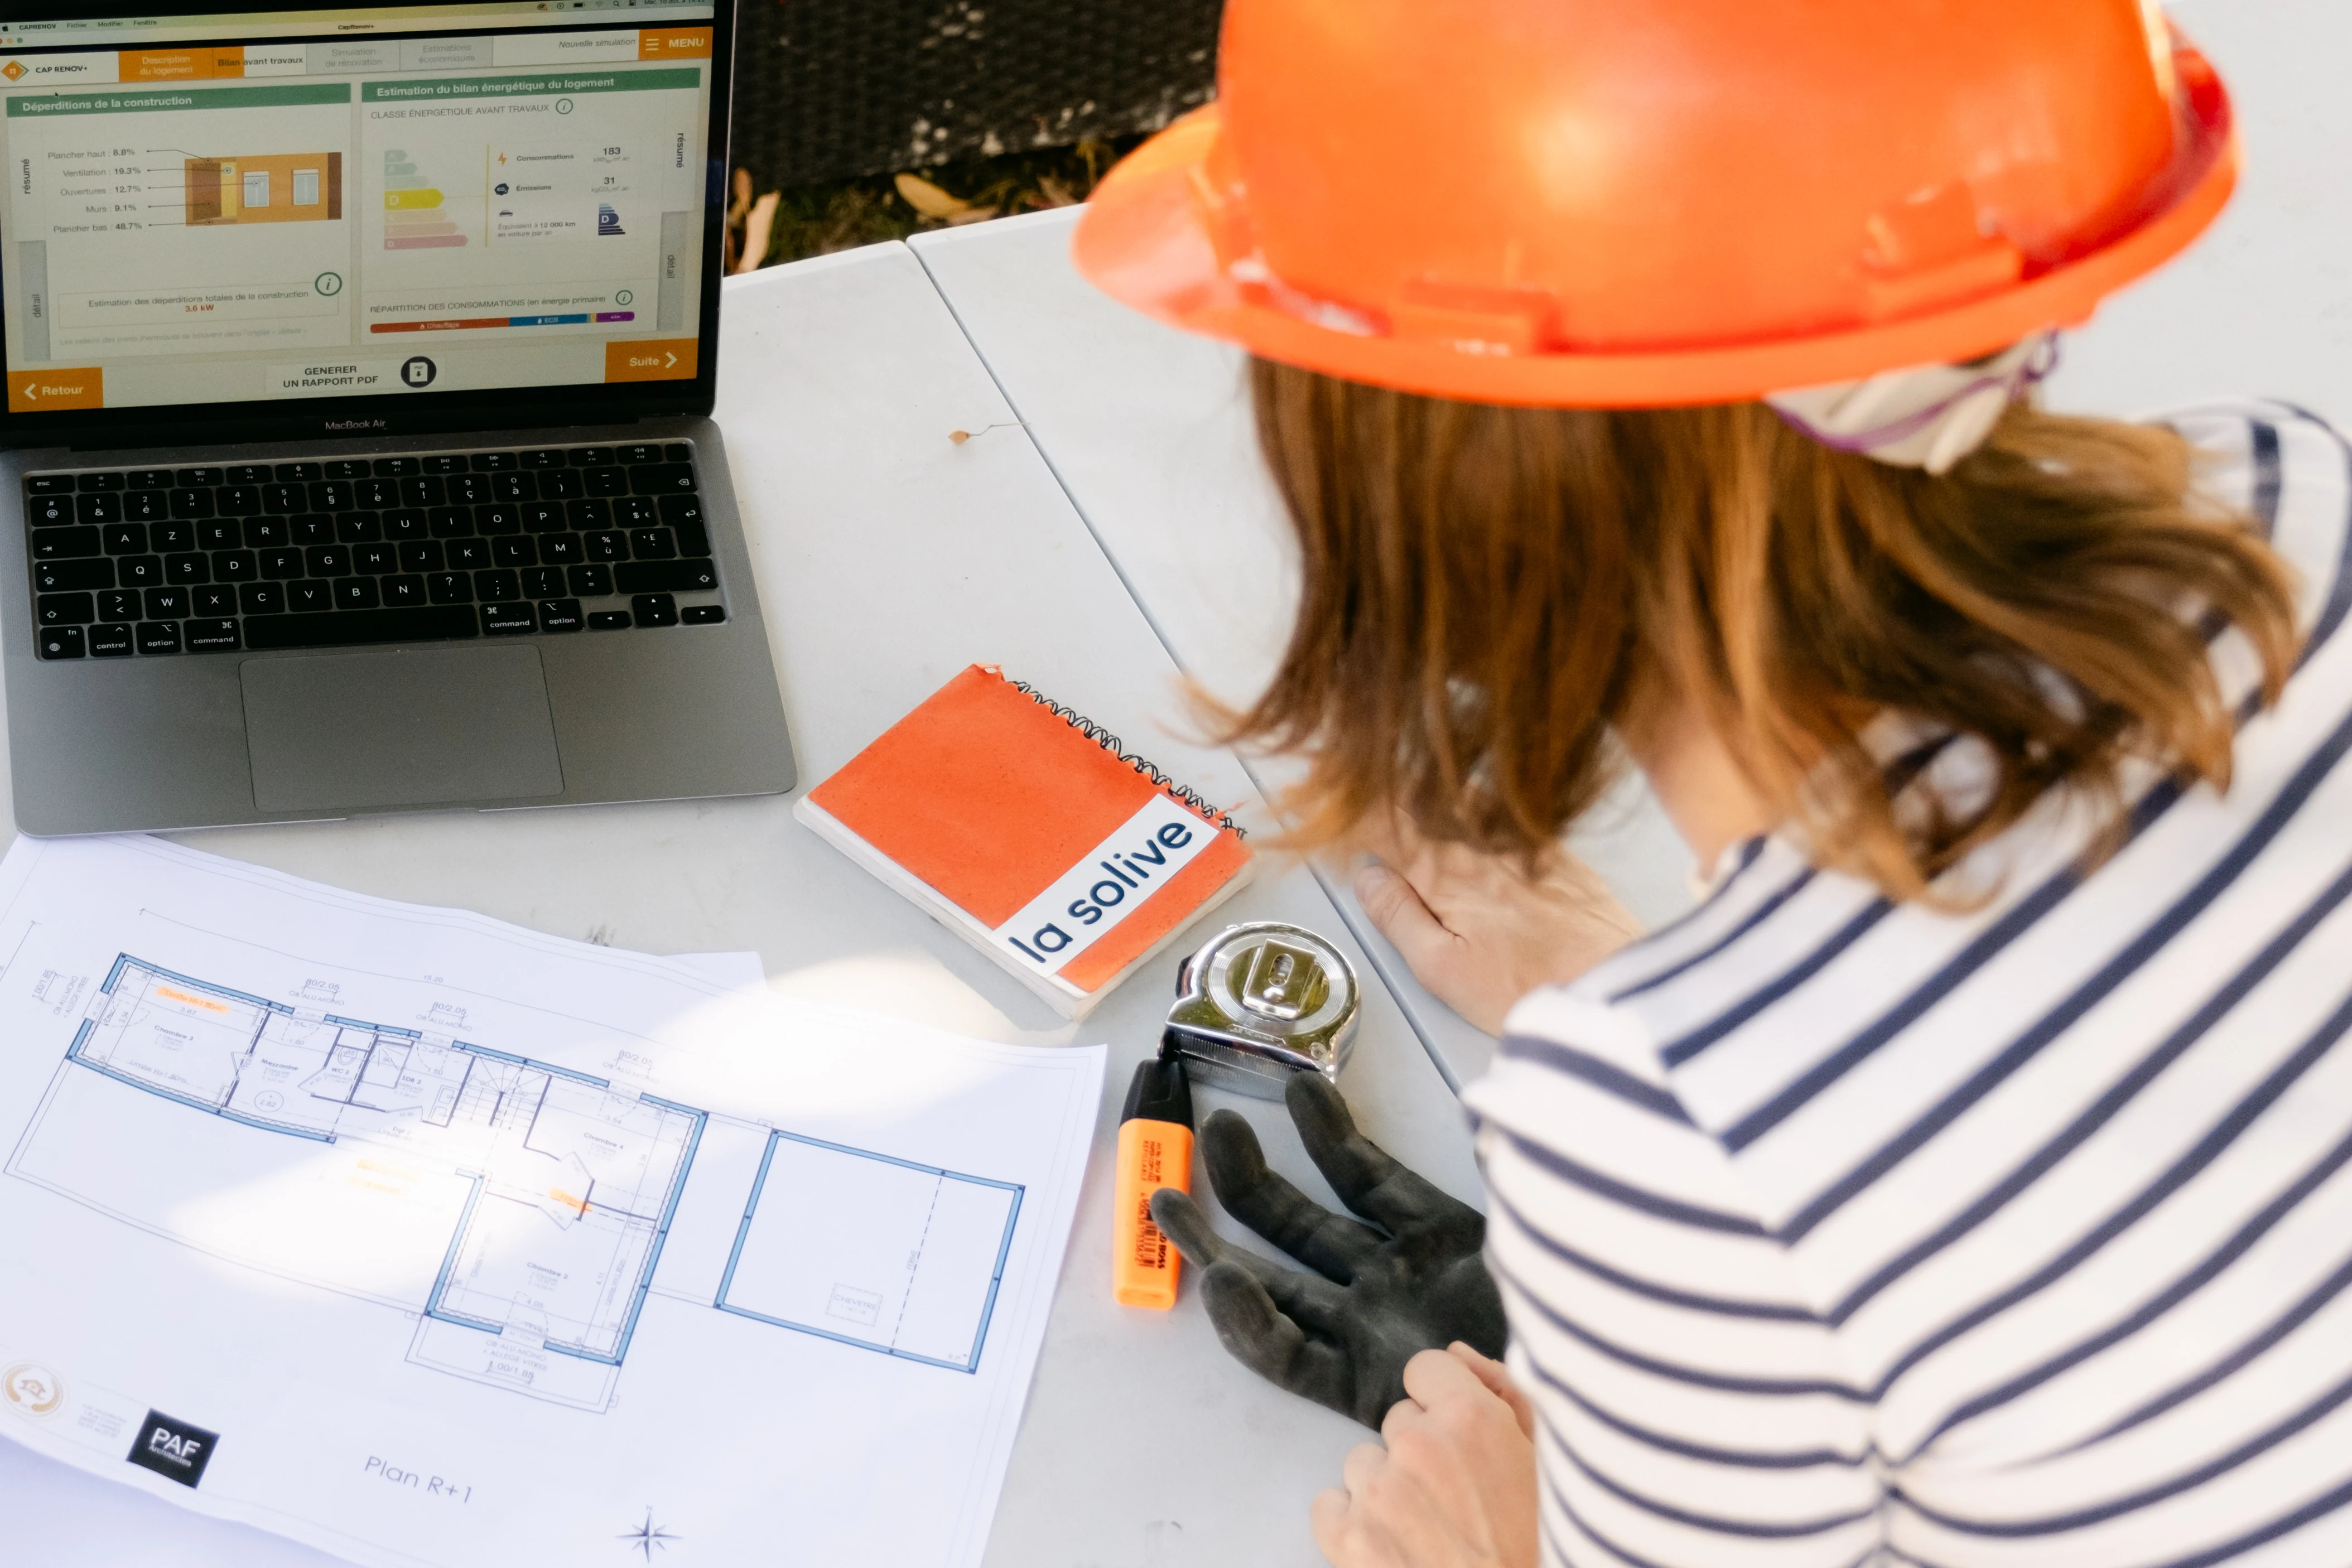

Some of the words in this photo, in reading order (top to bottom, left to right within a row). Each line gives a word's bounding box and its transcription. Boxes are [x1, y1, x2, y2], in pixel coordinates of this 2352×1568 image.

[558, 40, 593, 49] Nouvelle
[595, 38, 635, 47] simulation
[669, 38, 704, 47] MENU
[331, 48, 376, 57] Simulation
[423, 45, 471, 53] Estimations
[142, 56, 190, 65] Description
[338, 59, 383, 67] rénovation
[418, 55, 475, 64] économiques
[153, 66, 193, 76] logement
[377, 86, 433, 97] Estimation
[436, 85, 450, 94] du
[453, 84, 478, 93] bilan
[481, 81, 545, 94] énergétique
[548, 80, 561, 89] du
[564, 78, 614, 90] logement
[22, 100, 91, 112] Déperditions
[94, 100, 108, 109] de
[111, 99, 121, 108] la
[124, 97, 192, 107] construction
[370, 110, 406, 119] CLASSE
[475, 106, 505, 115] AVANT
[508, 104, 549, 113] TRAVAUX
[676, 133, 686, 168] résumé
[21, 158, 30, 195] résumé
[62, 168, 106, 177] Ventilation
[389, 195, 399, 206] D
[89, 299, 132, 307] Estimation
[152, 295, 203, 305] déperditions
[258, 291, 309, 300] construction
[447, 299, 526, 310] CONSOMMATIONS
[527, 298, 539, 307] (en
[541, 296, 570, 307] énergie
[572, 295, 606, 306] primaire)
[31, 293, 42, 318] détail
[629, 356, 659, 367] Suite
[305, 365, 357, 375] GENERER
[283, 379, 298, 388] UN
[302, 377, 354, 387] RAPPORT
[357, 375, 379, 384] PDF
[42, 385, 84, 396] Retour
[325, 421, 370, 430] MacBook
[493, 514, 502, 523] O
[539, 512, 547, 520] P
[401, 519, 409, 528] U
[261, 527, 269, 535] R
[308, 524, 316, 533] T
[121, 534, 129, 542] A
[168, 532, 176, 540] Z
[215, 529, 223, 538] E
[510, 546, 518, 554] L
[555, 543, 566, 552] M
[370, 553, 379, 562] H
[419, 551, 425, 559] J
[464, 549, 473, 557] K
[277, 558, 284, 567] F
[324, 556, 332, 565] G
[184, 563, 192, 572] S
[230, 561, 239, 570] D
[136, 566, 144, 575] Q
[352, 588, 360, 596] B
[399, 585, 408, 594] N
[258, 593, 266, 602] C
[304, 590, 313, 599] V
[161, 597, 173, 606] W
[210, 596, 219, 605] X
[490, 620, 530, 628] command
[193, 636, 234, 644] command
[1008, 923, 1073, 963] la
[1067, 822, 1193, 925] solive
[154, 1025, 187, 1039] Chambre
[261, 1058, 299, 1071] Mezzanine
[584, 1132, 618, 1148] Chambre
[1157, 1244, 1167, 1269] BOSS
[527, 1261, 561, 1277] Chambre
[151, 1427, 201, 1458] PAF
[365, 1455, 419, 1488] Plan
[427, 1475, 472, 1503] R+1
